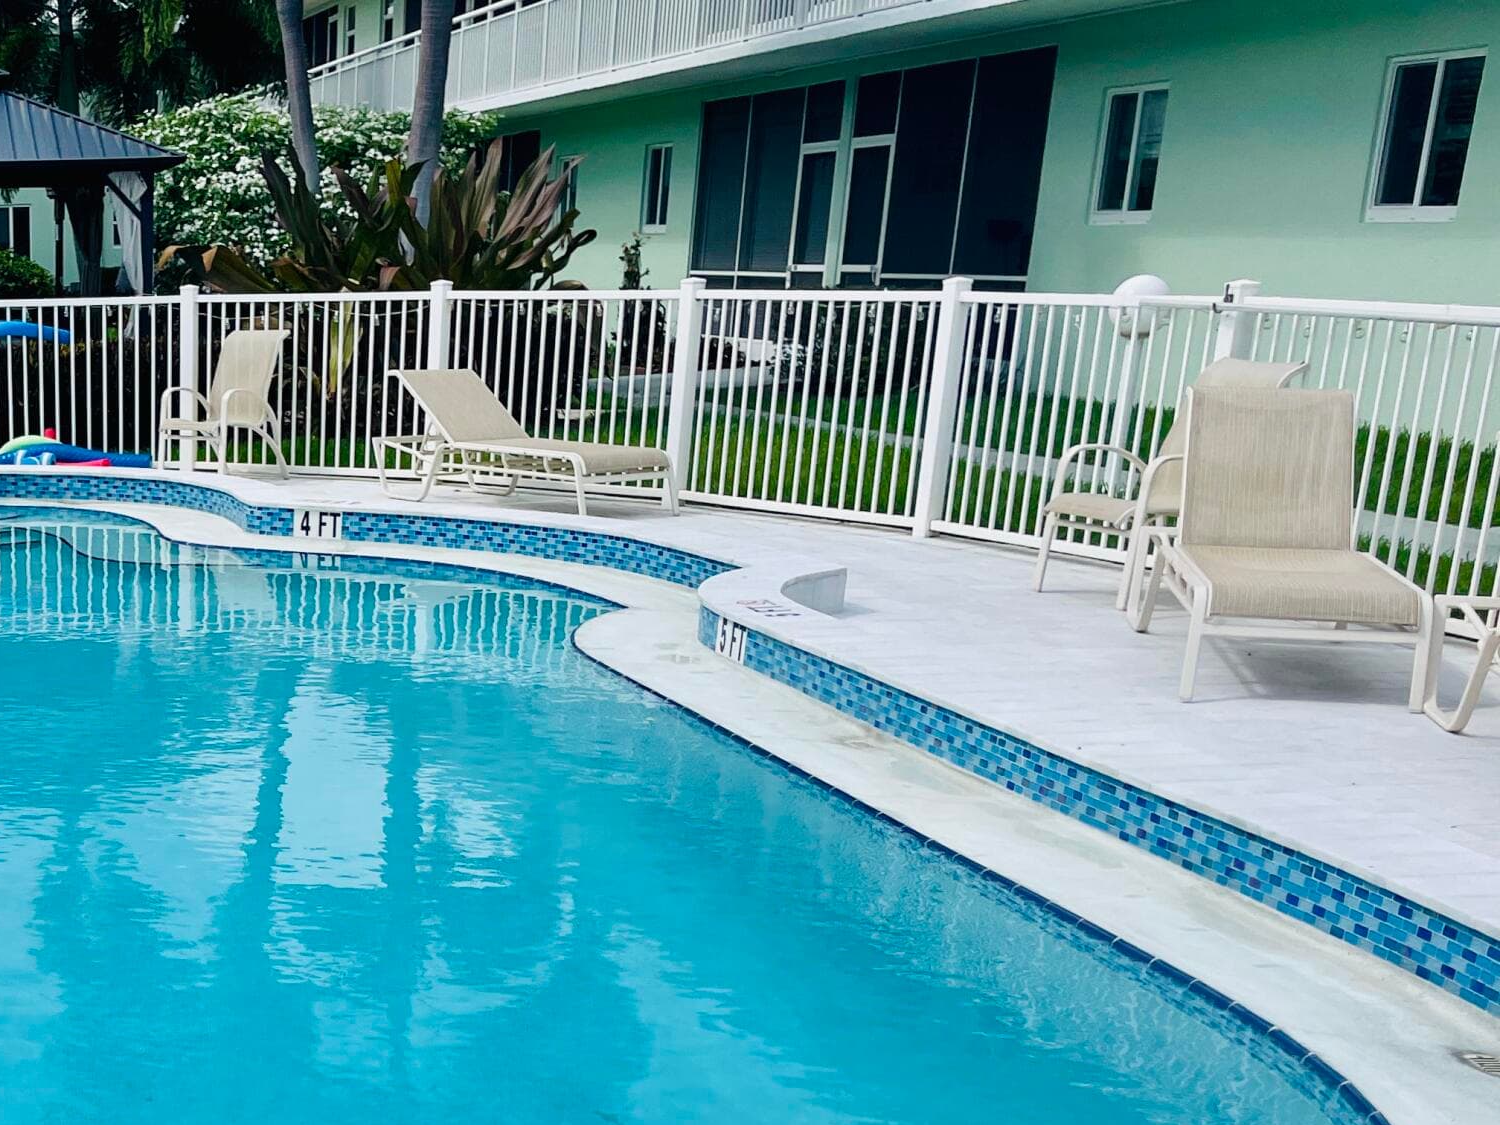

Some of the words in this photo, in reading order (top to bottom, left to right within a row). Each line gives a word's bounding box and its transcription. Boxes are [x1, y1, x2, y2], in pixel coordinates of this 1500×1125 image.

[300, 511, 311, 536] 4
[319, 512, 340, 537] FT
[719, 617, 728, 652] 5
[729, 622, 746, 661] FT
